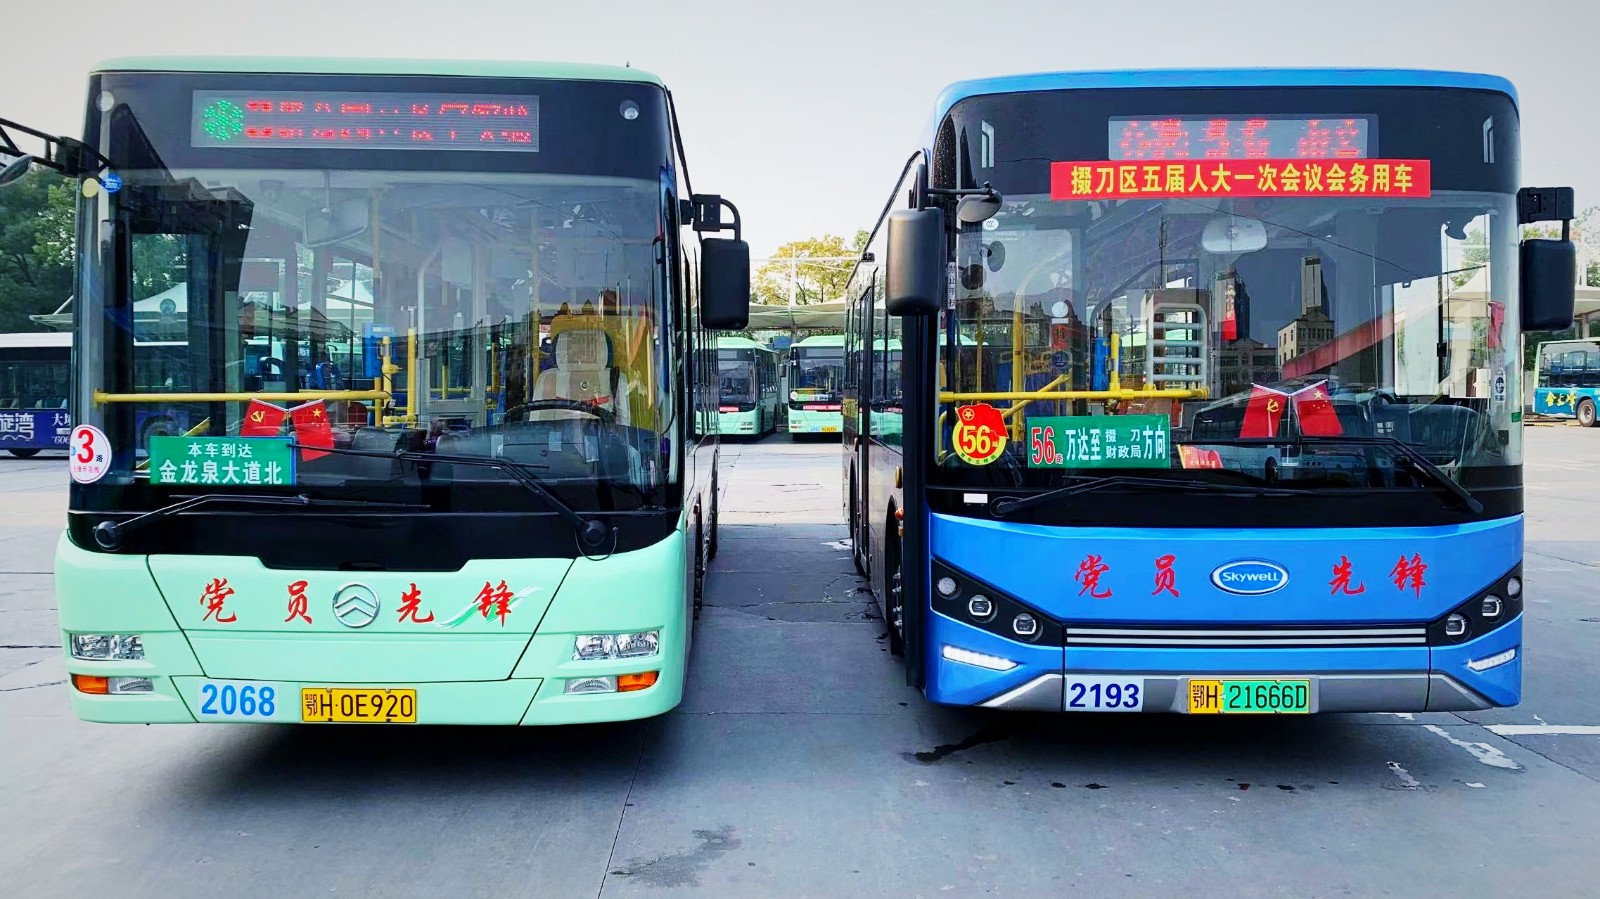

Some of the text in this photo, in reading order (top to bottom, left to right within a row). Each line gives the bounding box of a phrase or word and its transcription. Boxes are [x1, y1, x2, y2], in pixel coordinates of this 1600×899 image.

[1070, 163, 1412, 195] 掇刀区五届人大一次会议会务用车
[188, 442, 253, 457] 本车到达
[1106, 445, 1141, 459] 财政局
[1143, 425, 1166, 460] 方向
[159, 459, 282, 484] 金龙泉大道北
[201, 683, 275, 717] 2068
[1068, 683, 1140, 710] 2193
